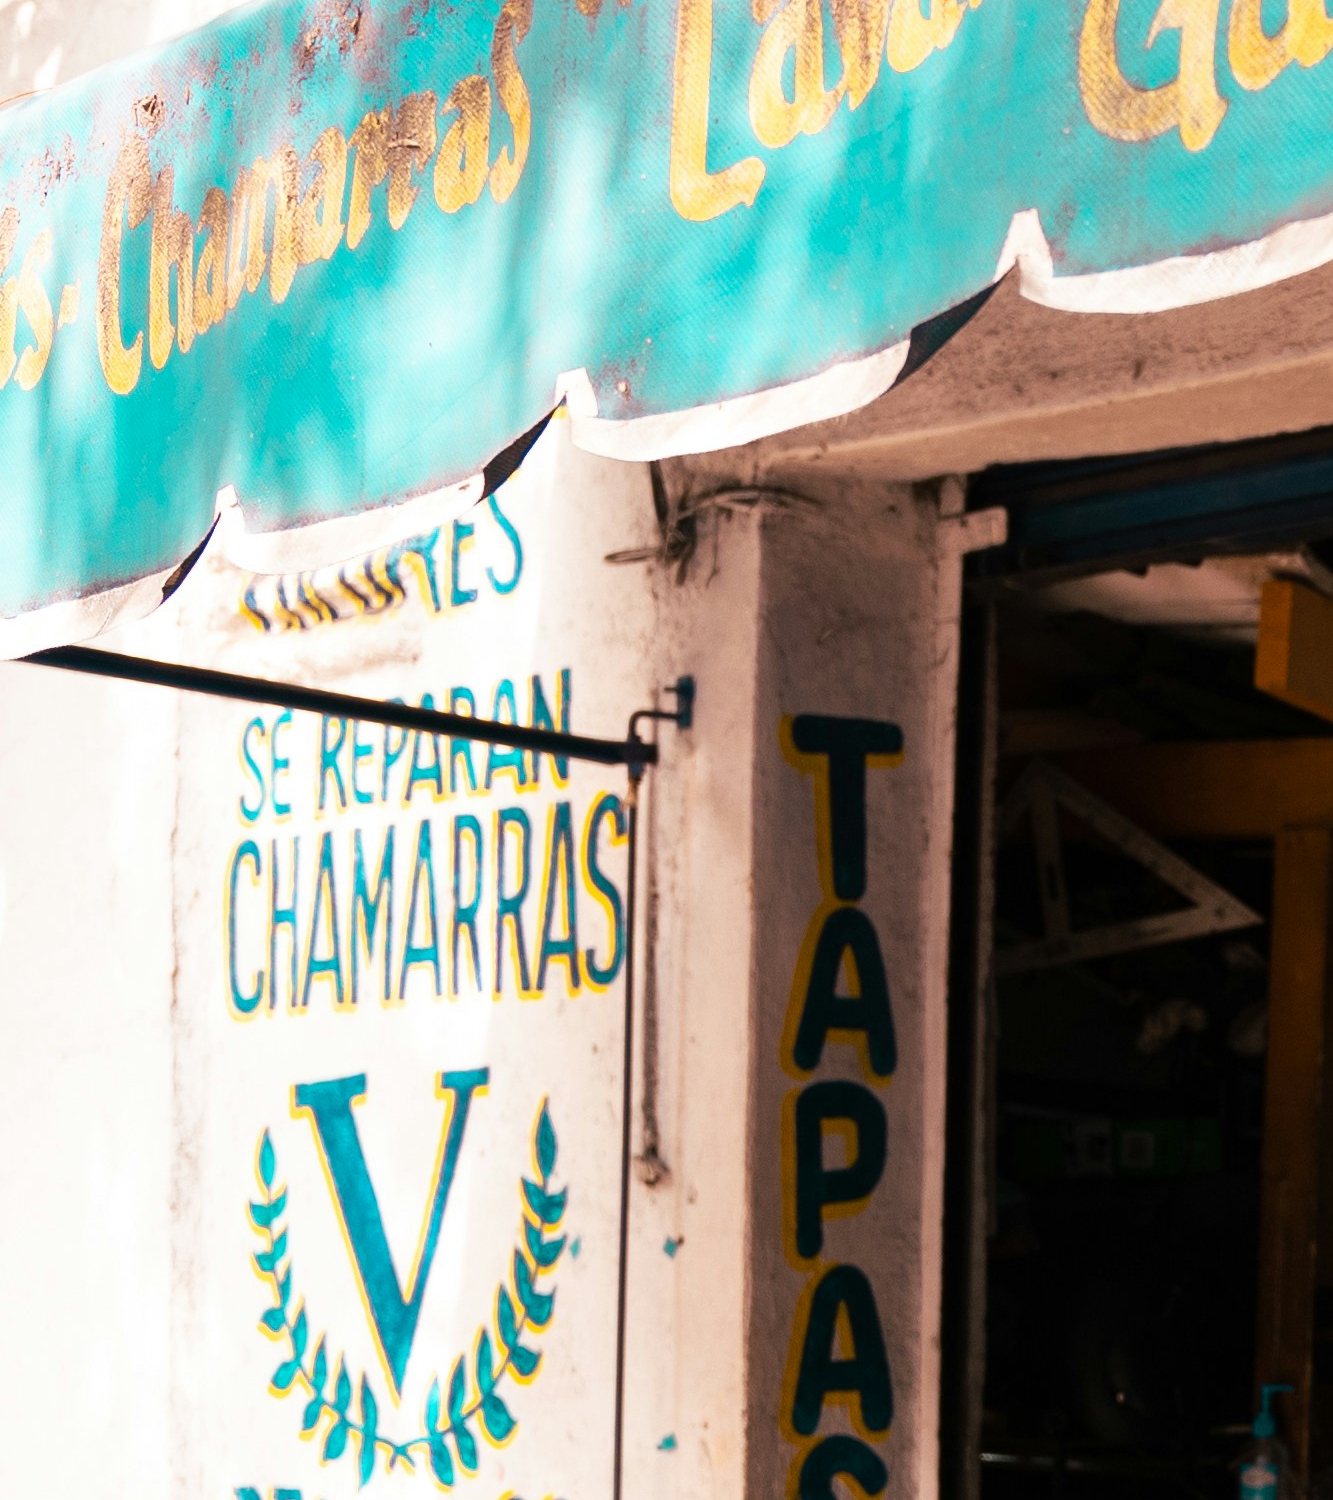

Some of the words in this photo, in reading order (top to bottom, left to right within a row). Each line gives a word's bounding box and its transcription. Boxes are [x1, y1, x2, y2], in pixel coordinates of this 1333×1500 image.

[234, 707, 295, 824] SE
[314, 667, 573, 810] REPARAN
[225, 792, 629, 1019] CHAMARRAS
[290, 1065, 489, 1400] V
